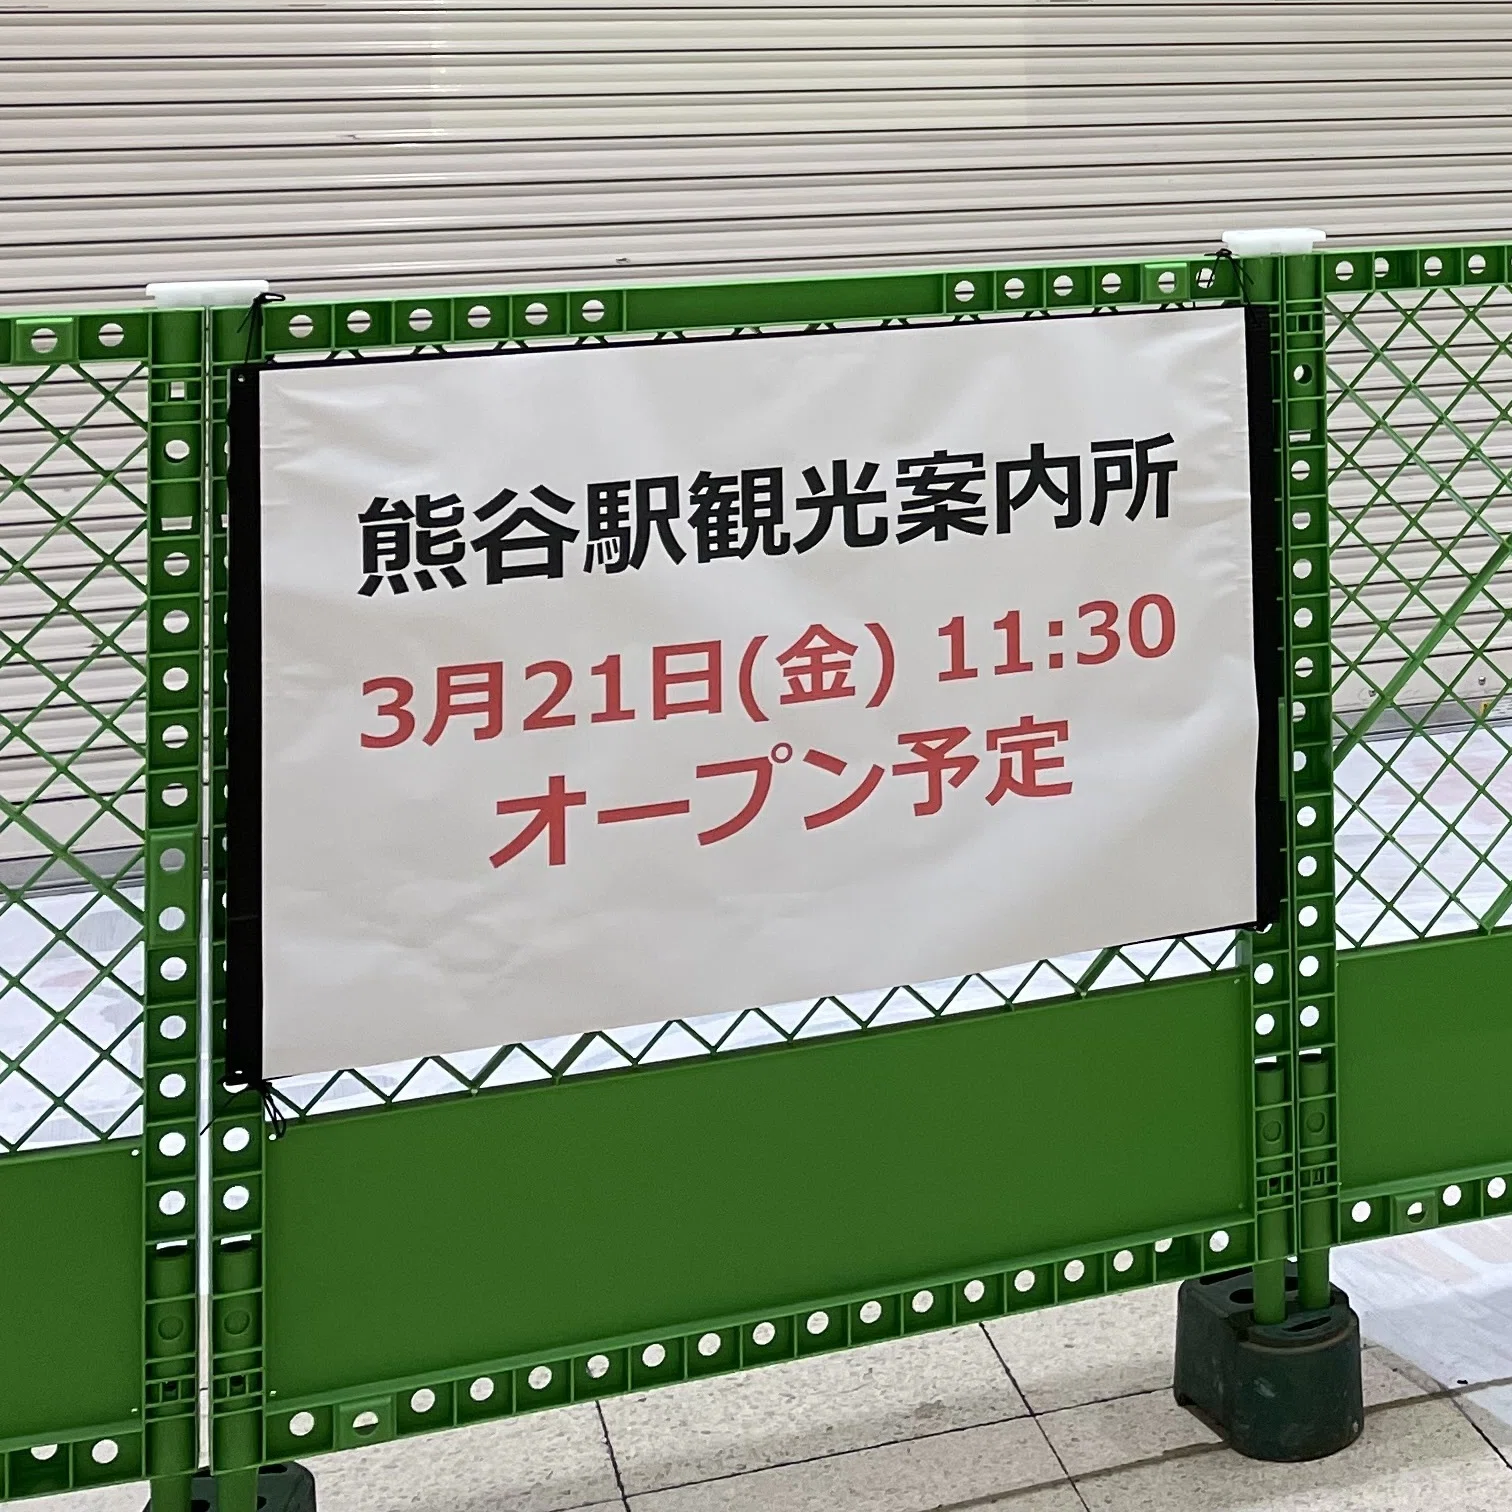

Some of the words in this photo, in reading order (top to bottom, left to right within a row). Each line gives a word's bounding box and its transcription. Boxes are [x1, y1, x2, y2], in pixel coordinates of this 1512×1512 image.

[358, 433, 1178, 597] 熊谷駅観光案内所
[360, 622, 895, 749] 3月21日(金)
[938, 593, 1176, 682] 11:30
[489, 715, 1073, 868] オープン予定
